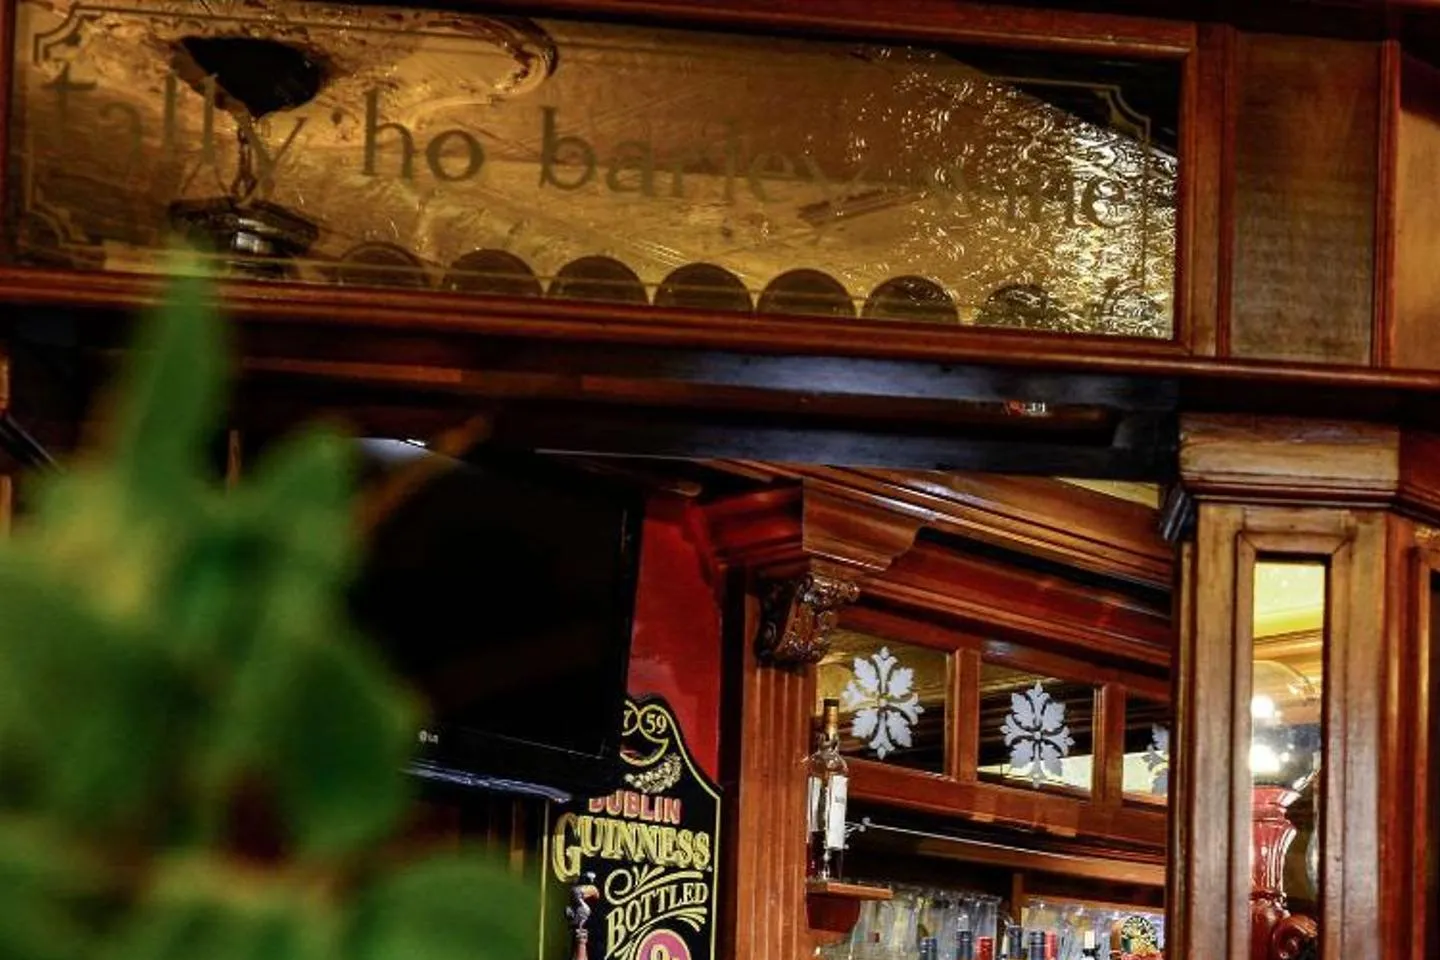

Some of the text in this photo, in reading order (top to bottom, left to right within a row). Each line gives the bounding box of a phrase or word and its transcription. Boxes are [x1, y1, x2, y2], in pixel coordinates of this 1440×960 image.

[362, 90, 486, 183] ho
[645, 712, 668, 735] 59
[552, 812, 712, 882] GUINNESS
[604, 880, 709, 951] BOTTLED
